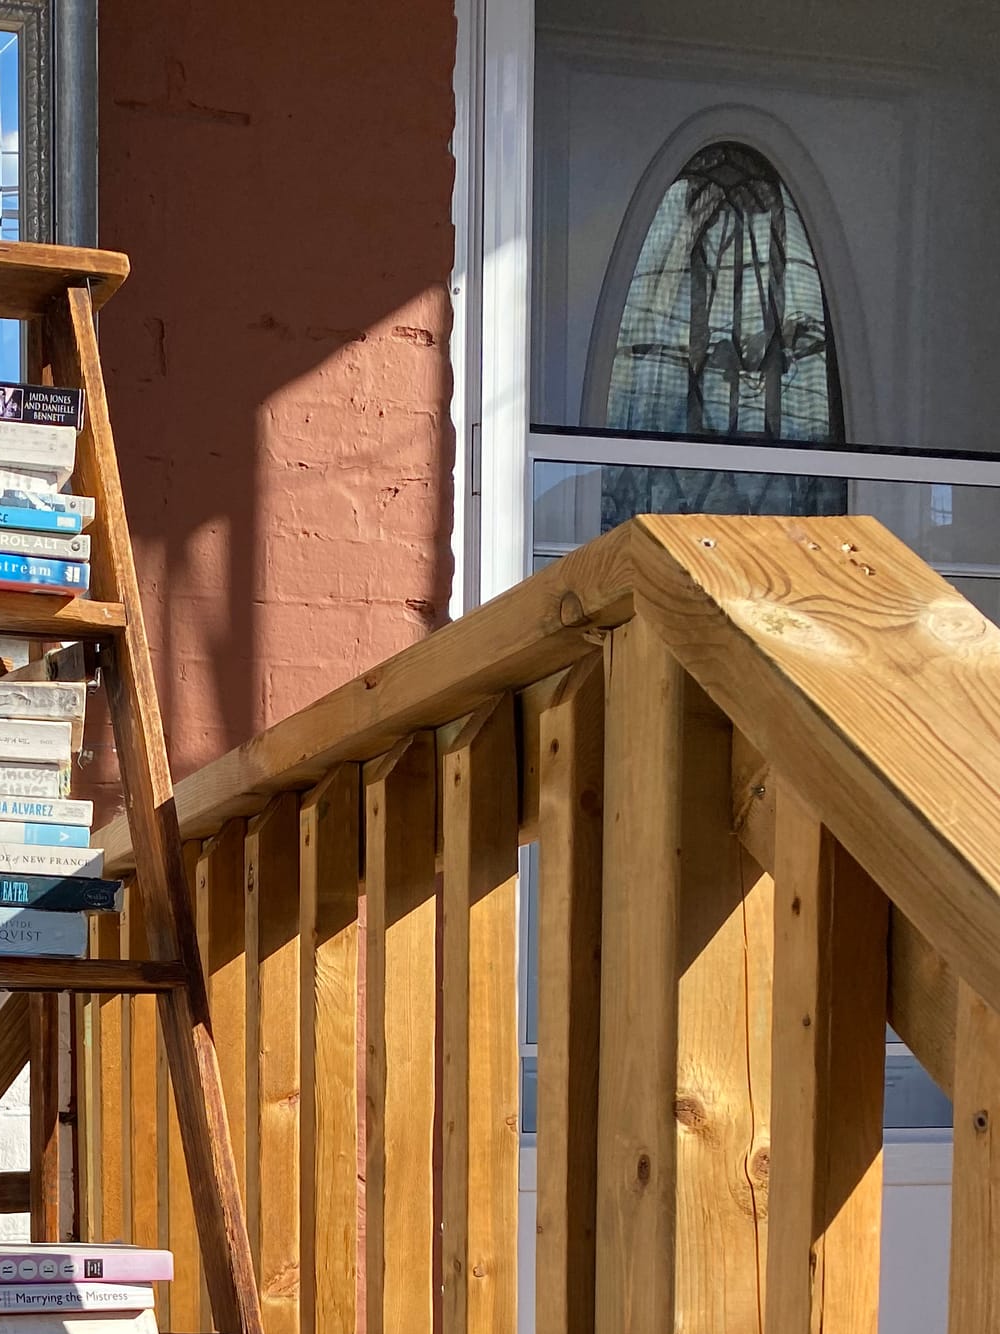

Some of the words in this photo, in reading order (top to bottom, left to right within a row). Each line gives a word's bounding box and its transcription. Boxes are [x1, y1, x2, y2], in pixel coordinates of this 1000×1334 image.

[28, 392, 48, 403] JAIDA
[49, 392, 72, 404] JONES
[24, 401, 40, 412] AND
[41, 402, 75, 414] DANIELLE
[33, 411, 66, 422] BENNETT
[33, 536, 60, 550] ALT
[11, 803, 54, 817] ALVAREZ
[22, 856, 46, 865] NEW
[2, 881, 29, 903] EATER
[15, 1291, 63, 1306] Marrying
[65, 1290, 84, 1303] the
[85, 1290, 128, 1302] Mistress
